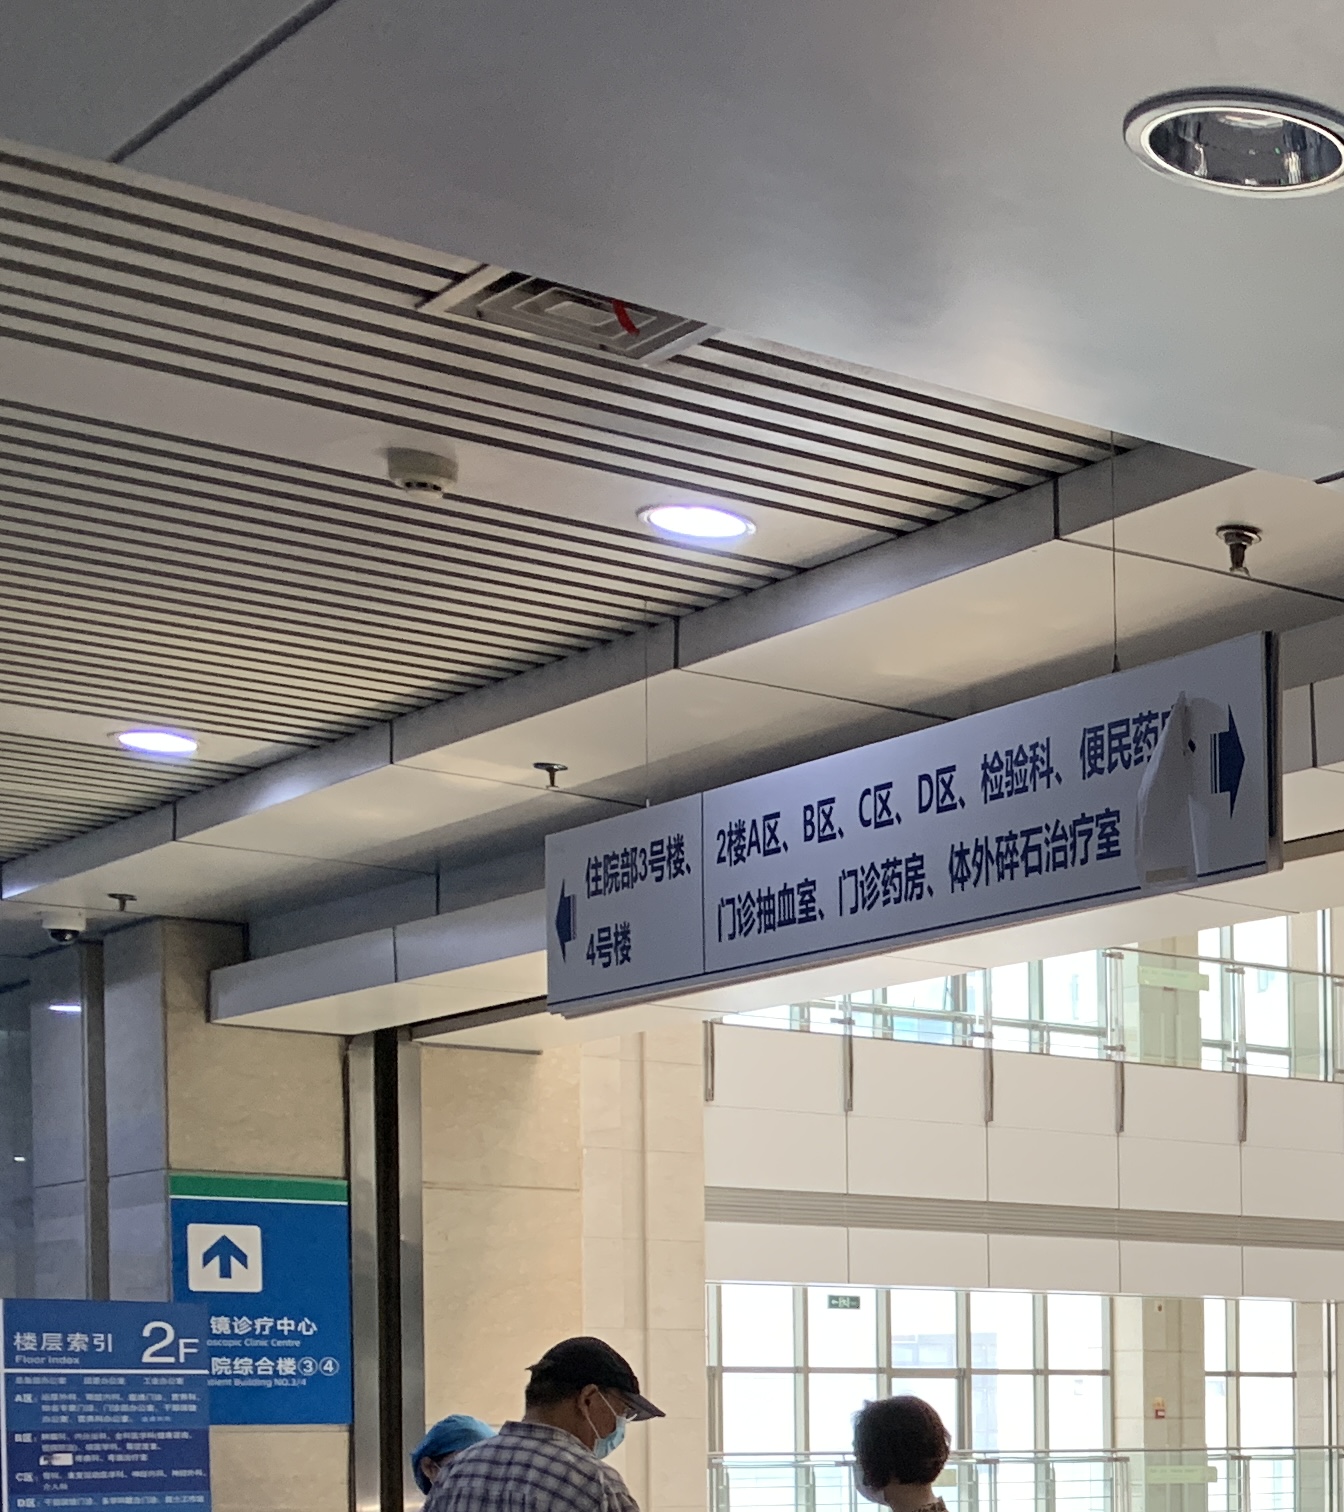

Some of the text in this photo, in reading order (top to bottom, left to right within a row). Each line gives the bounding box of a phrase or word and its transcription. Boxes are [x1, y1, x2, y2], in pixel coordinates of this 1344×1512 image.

[716, 705, 1173, 867] 2楼A区、B区、C区、D区、检验科、便民药
[586, 922, 632, 968] 4号楼
[13, 1320, 200, 1364] 楼层索引 2F
[209, 1315, 318, 1336] 镜诊疗中心
[15, 1355, 47, 1365] Floor
